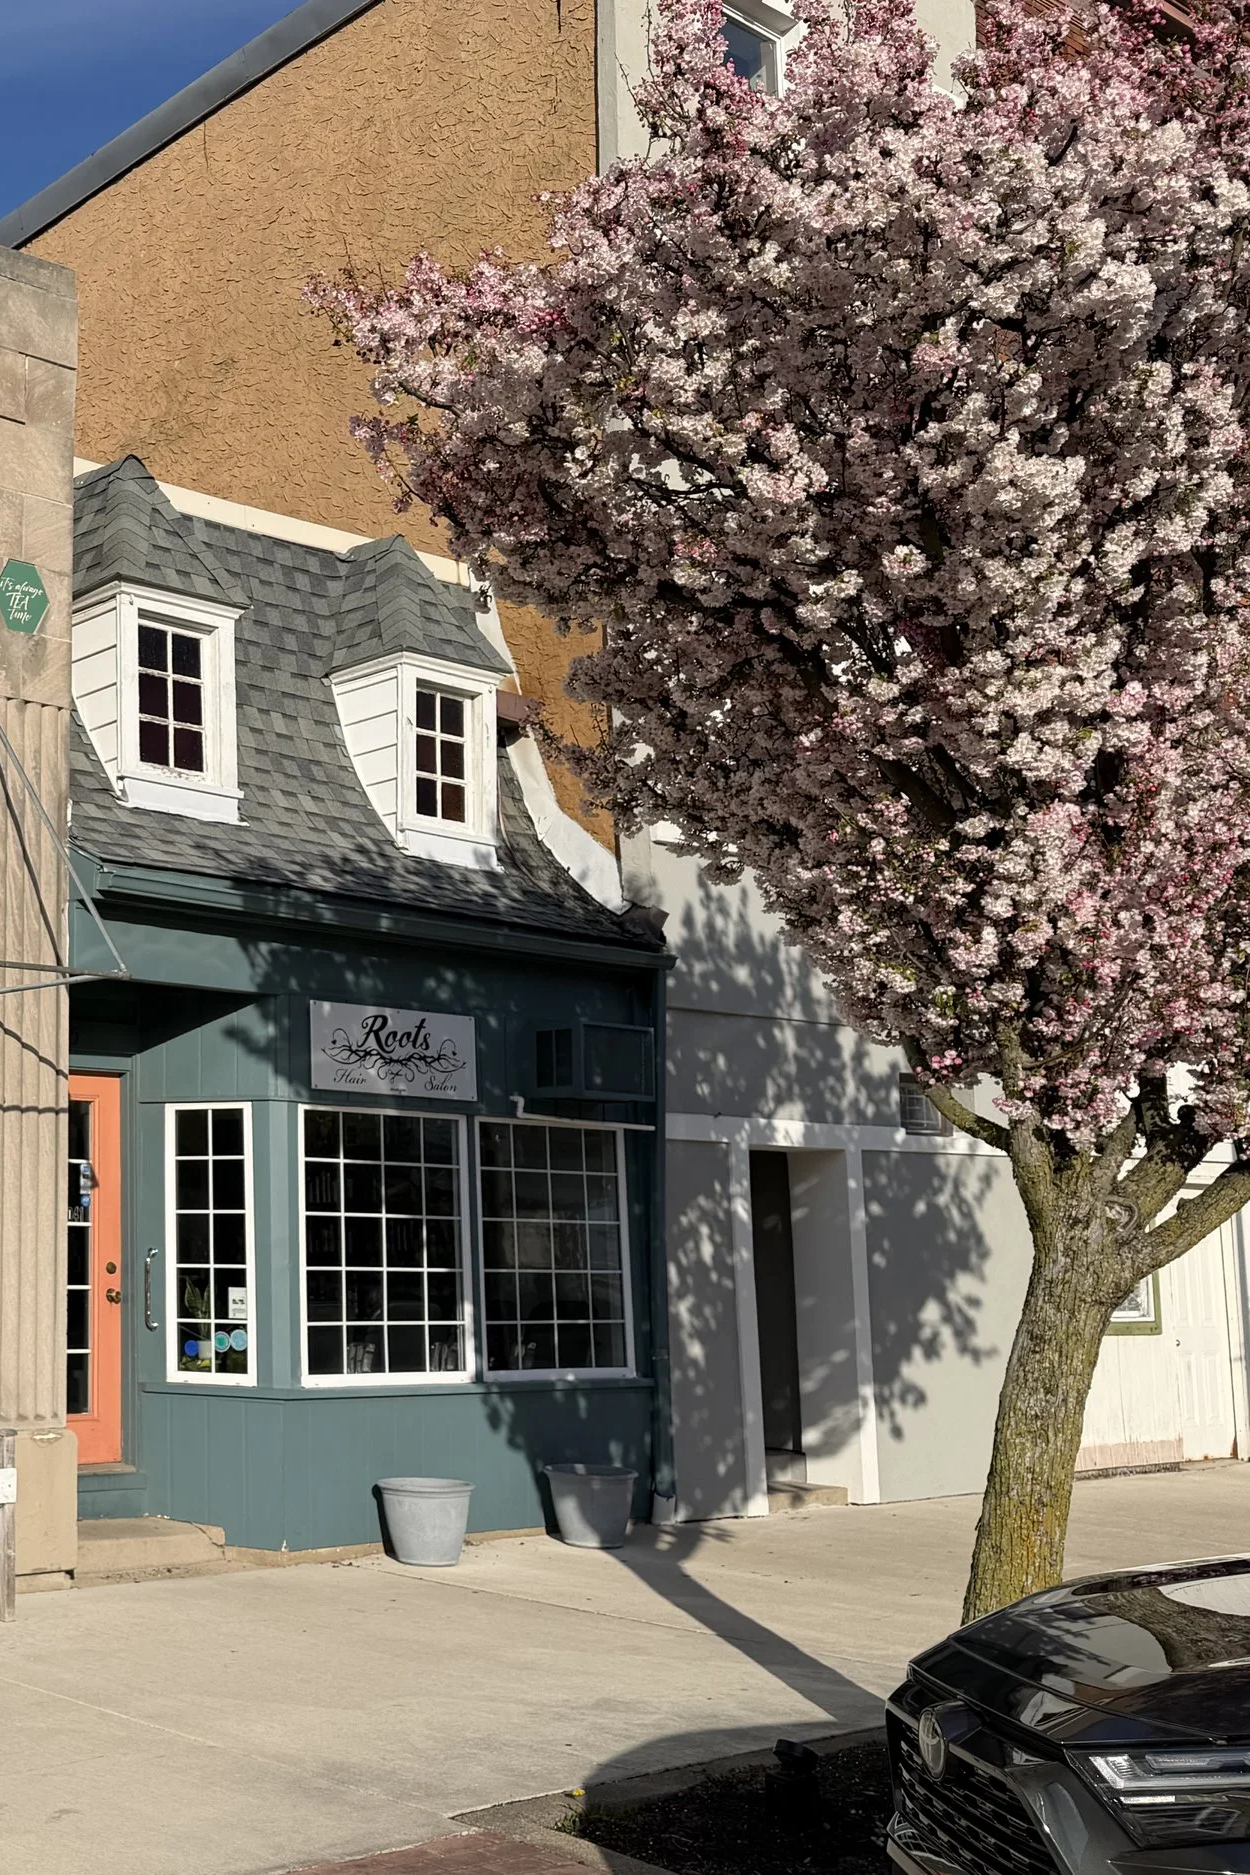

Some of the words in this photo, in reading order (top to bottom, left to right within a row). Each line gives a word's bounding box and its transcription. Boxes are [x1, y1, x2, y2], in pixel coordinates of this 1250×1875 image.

[15, 581, 43, 598] always
[6, 592, 29, 610] TEA
[356, 1014, 431, 1054] Roots
[333, 1068, 367, 1086] Hair
[424, 1073, 458, 1093] Salon
